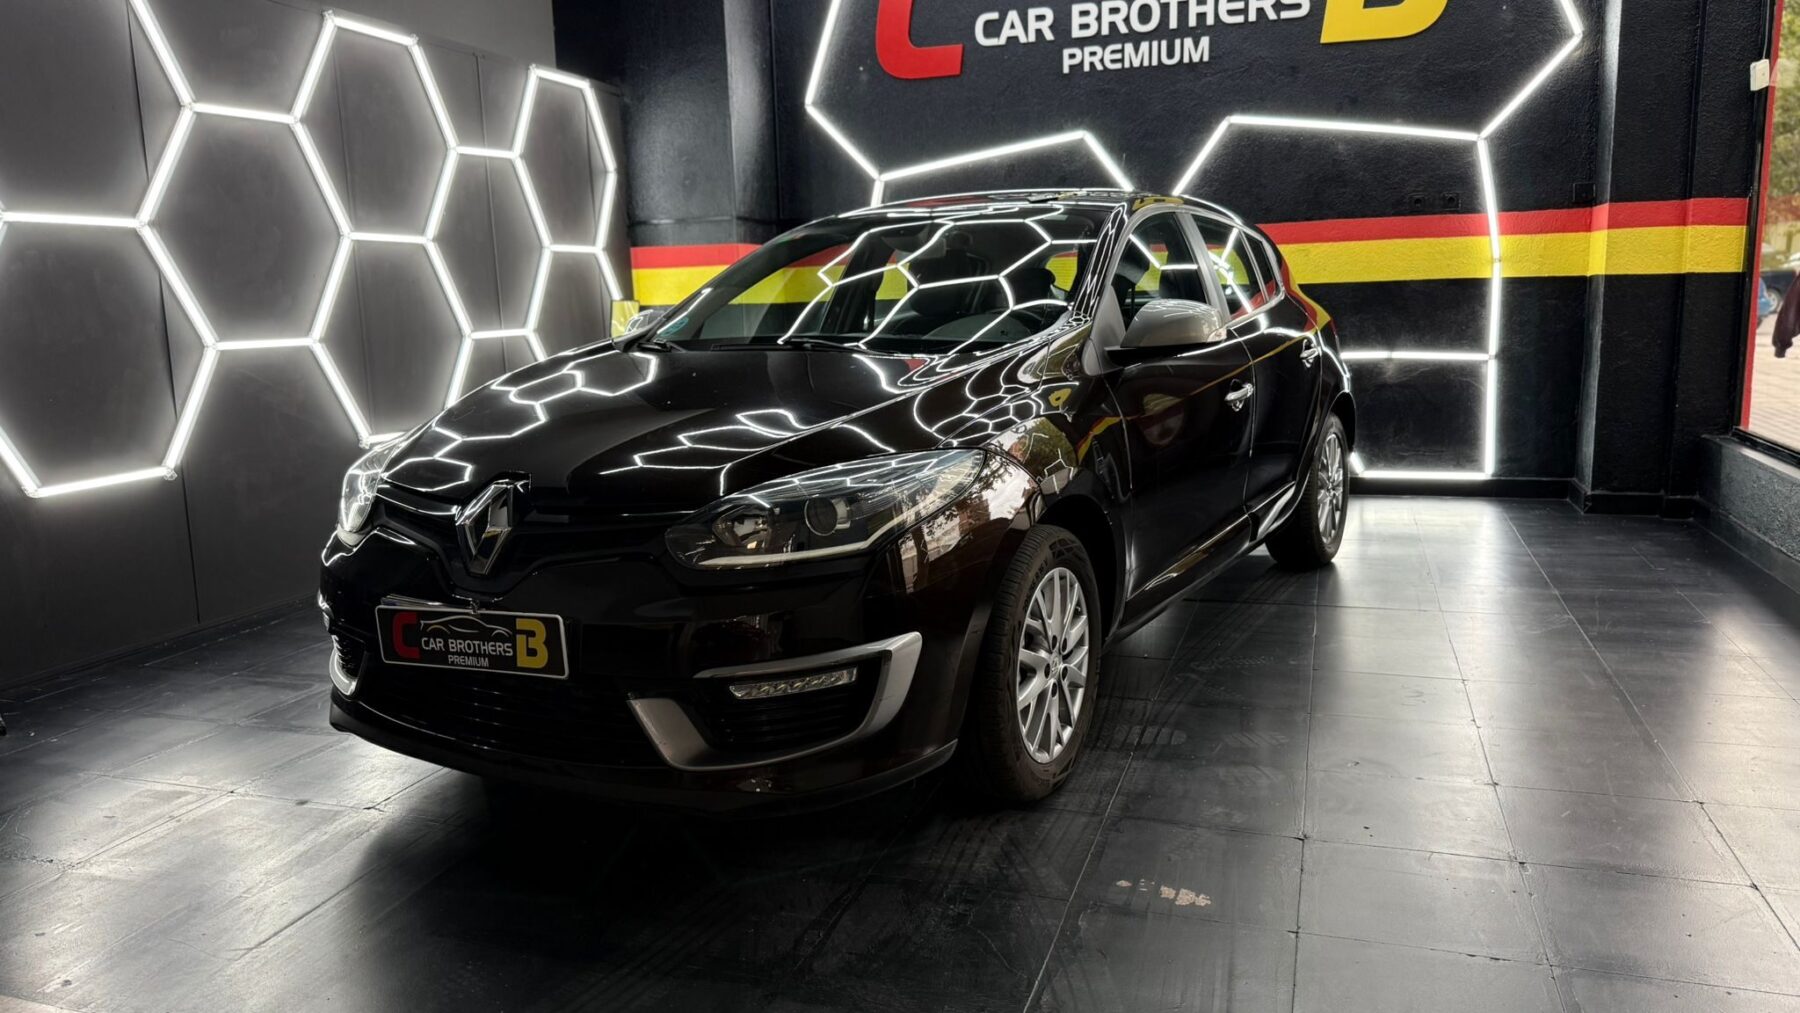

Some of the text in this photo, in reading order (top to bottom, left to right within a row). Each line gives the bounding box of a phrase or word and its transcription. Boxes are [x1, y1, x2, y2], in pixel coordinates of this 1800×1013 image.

[975, 7, 1055, 47] CAR
[1071, 0, 1311, 39] BROTHERS
[1062, 35, 1210, 74] PREMIUM
[421, 637, 514, 657] CAR BROTHERS
[448, 654, 490, 668] PREMIUM
